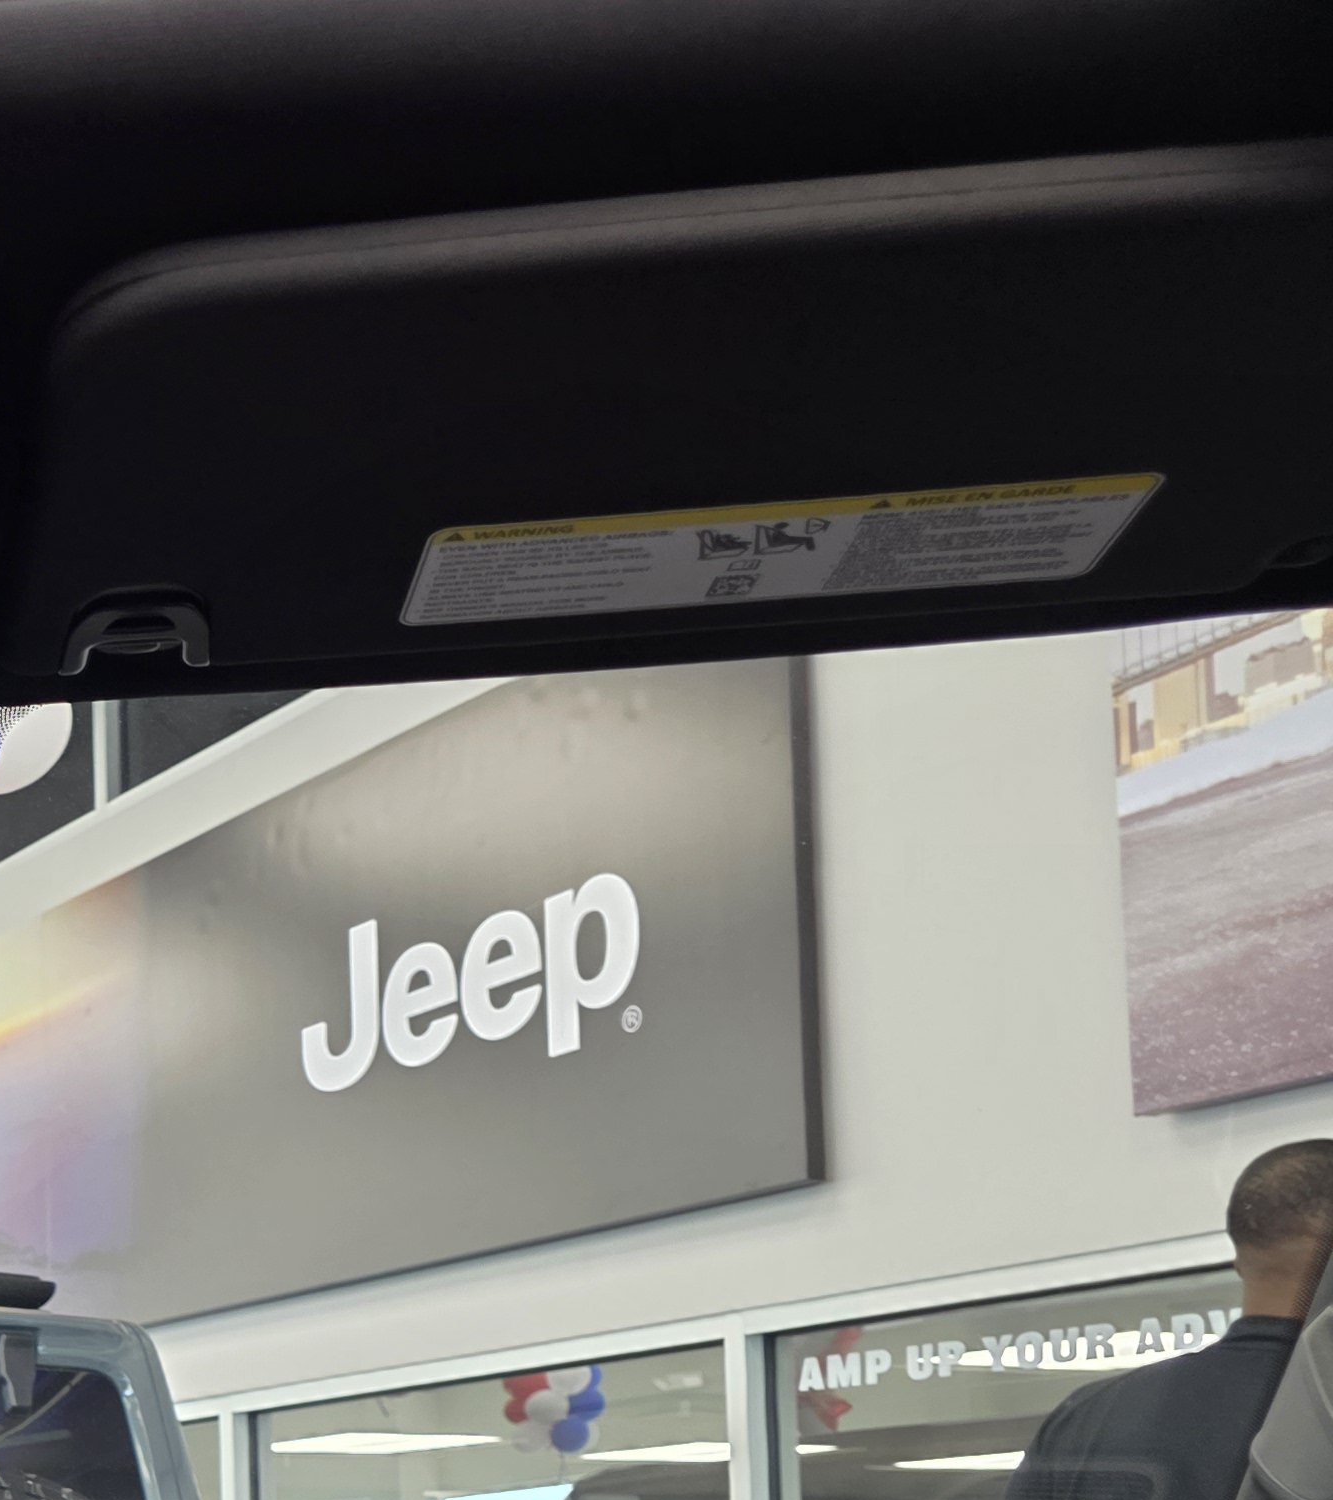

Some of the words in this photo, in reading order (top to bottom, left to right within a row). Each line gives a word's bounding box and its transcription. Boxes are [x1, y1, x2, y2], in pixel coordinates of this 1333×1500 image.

[472, 524, 574, 540] WARNING
[301, 872, 640, 1092] Jeep
[799, 1348, 891, 1391] AMP
[906, 1340, 966, 1380] UP
[981, 1322, 1116, 1371] YOUR
